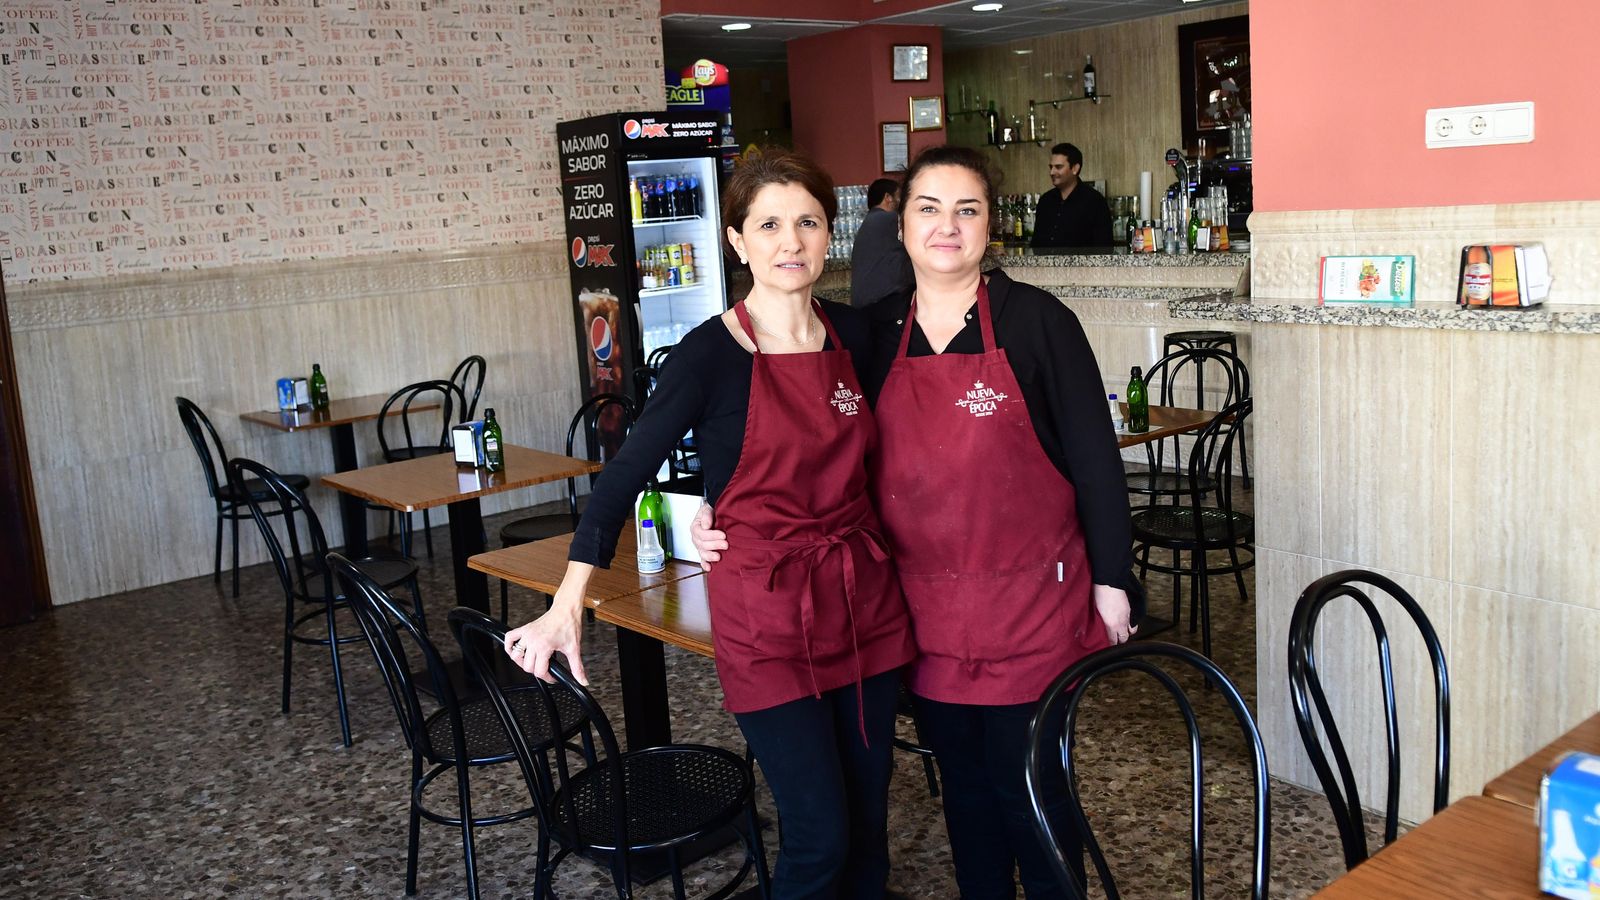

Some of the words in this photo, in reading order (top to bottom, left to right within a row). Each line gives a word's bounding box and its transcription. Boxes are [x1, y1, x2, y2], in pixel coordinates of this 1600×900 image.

[0, 9, 58, 20] OFFEE
[103, 24, 173, 36] KITCHN
[230, 27, 294, 38] KITCHN
[345, 29, 403, 40] KITCHN
[42, 86, 116, 98] KITCHN
[176, 86, 242, 97] KITCHN
[296, 86, 356, 96] KITCHN
[244, 143, 306, 155] KITCHN
[357, 140, 414, 151] KITCHN
[562, 133, 610, 154] MÁXIMO
[118, 146, 188, 159] KITCHN
[524, 161, 559, 171] BRASS
[568, 154, 606, 173] SABOR
[574, 184, 605, 200] ZERO
[308, 197, 367, 210] KITCHN
[190, 203, 255, 217] KITCHN
[569, 202, 614, 220] AZÚCAR
[59, 209, 131, 224] KITCHN
[966, 388, 996, 400] NUEVA
